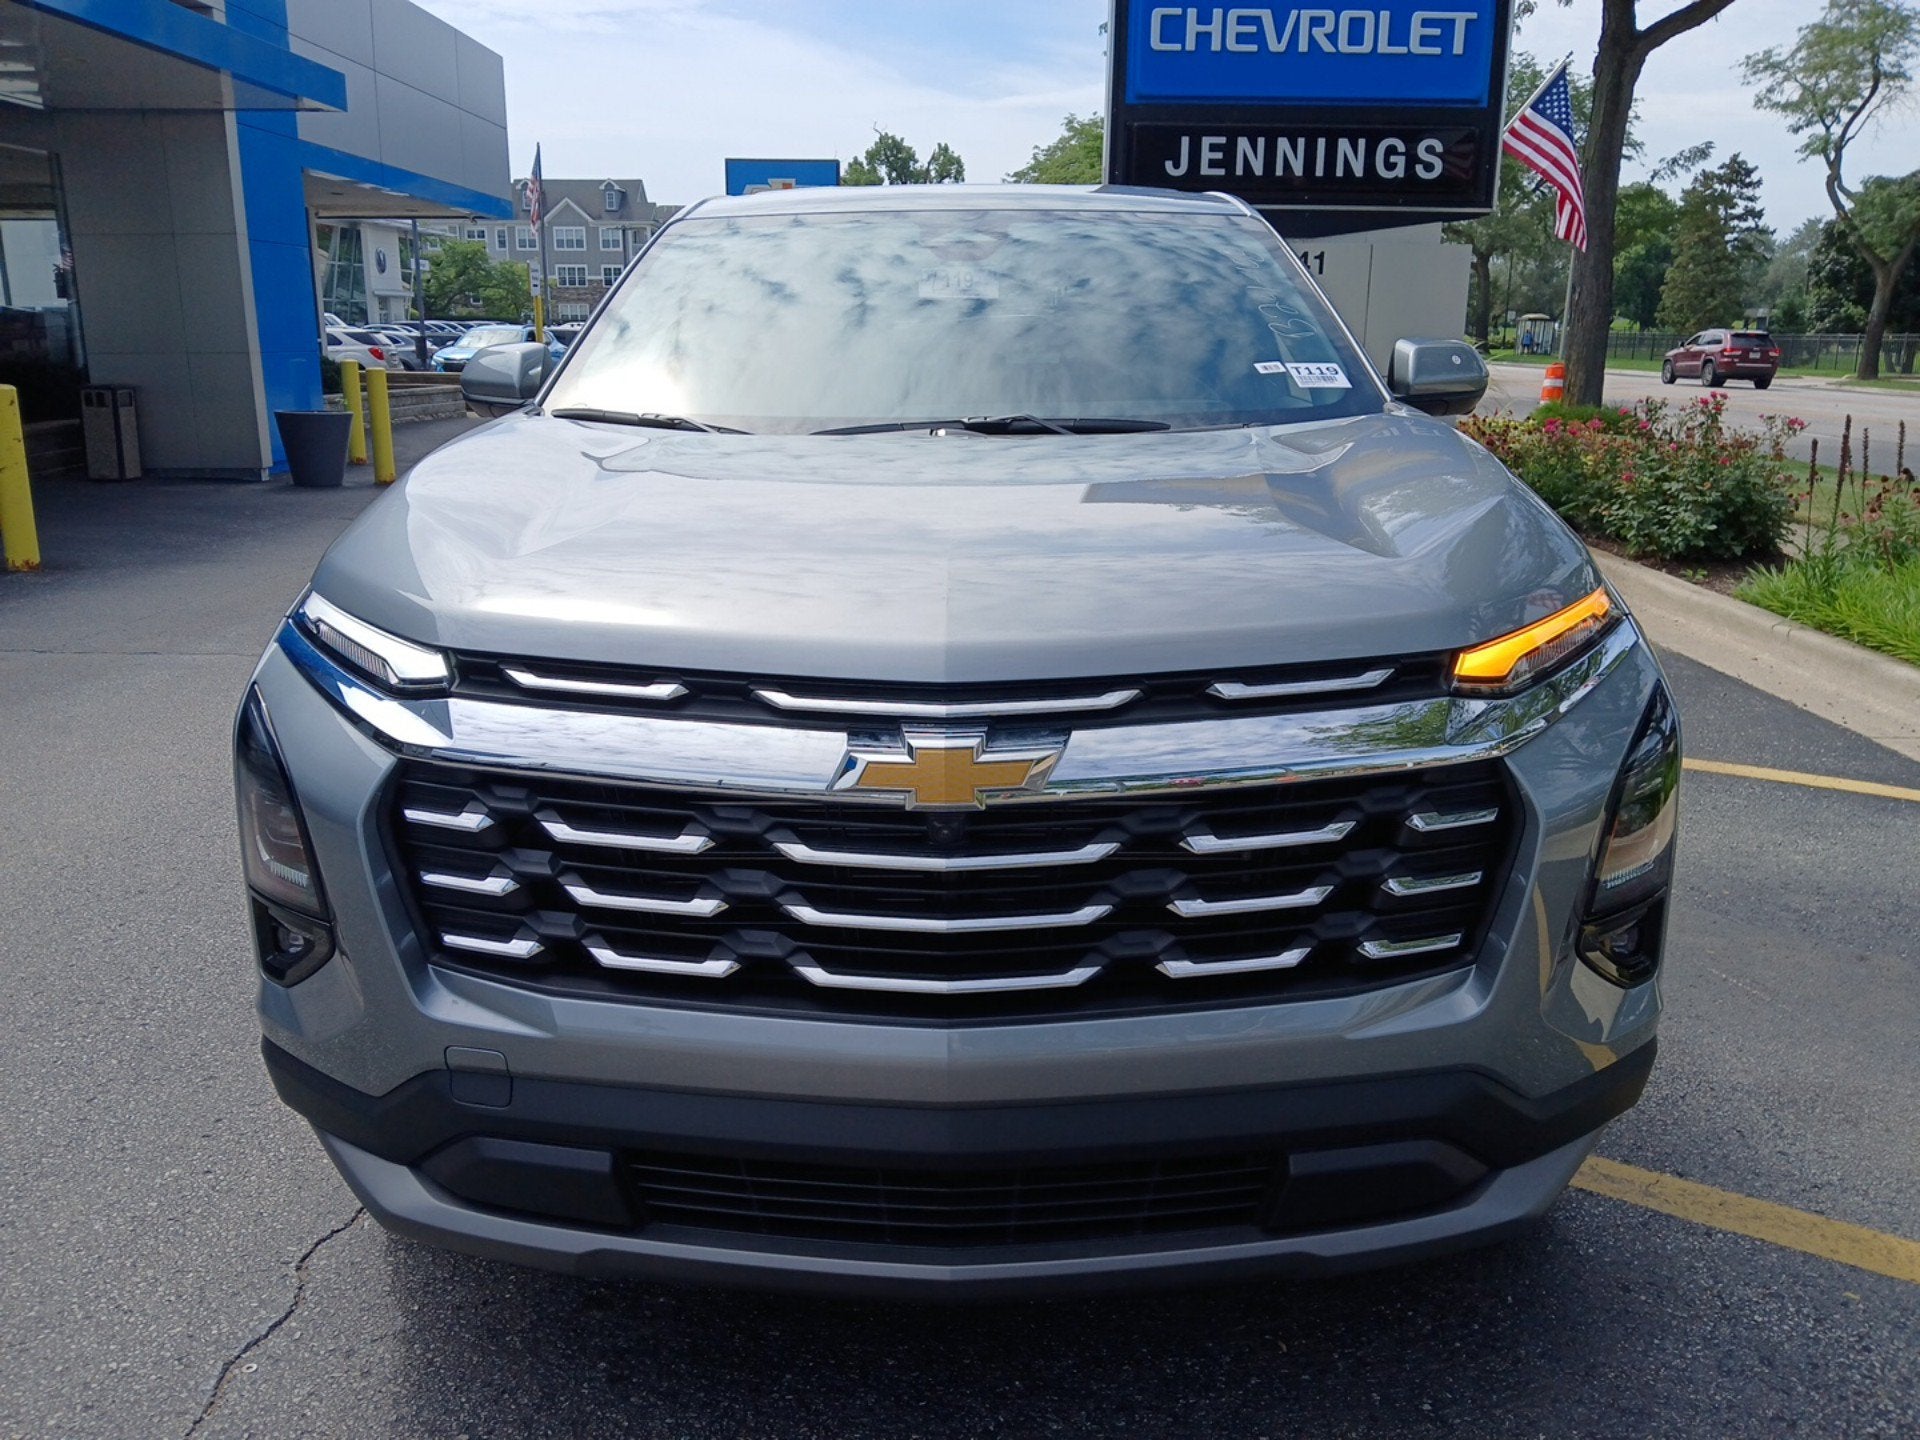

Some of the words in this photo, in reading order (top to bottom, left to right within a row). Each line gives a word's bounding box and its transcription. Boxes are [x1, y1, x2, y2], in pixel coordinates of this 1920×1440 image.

[1150, 7, 1478, 55] CHEVROLET
[1164, 135, 1444, 179] JENNINGS
[1290, 366, 1339, 376] T119
